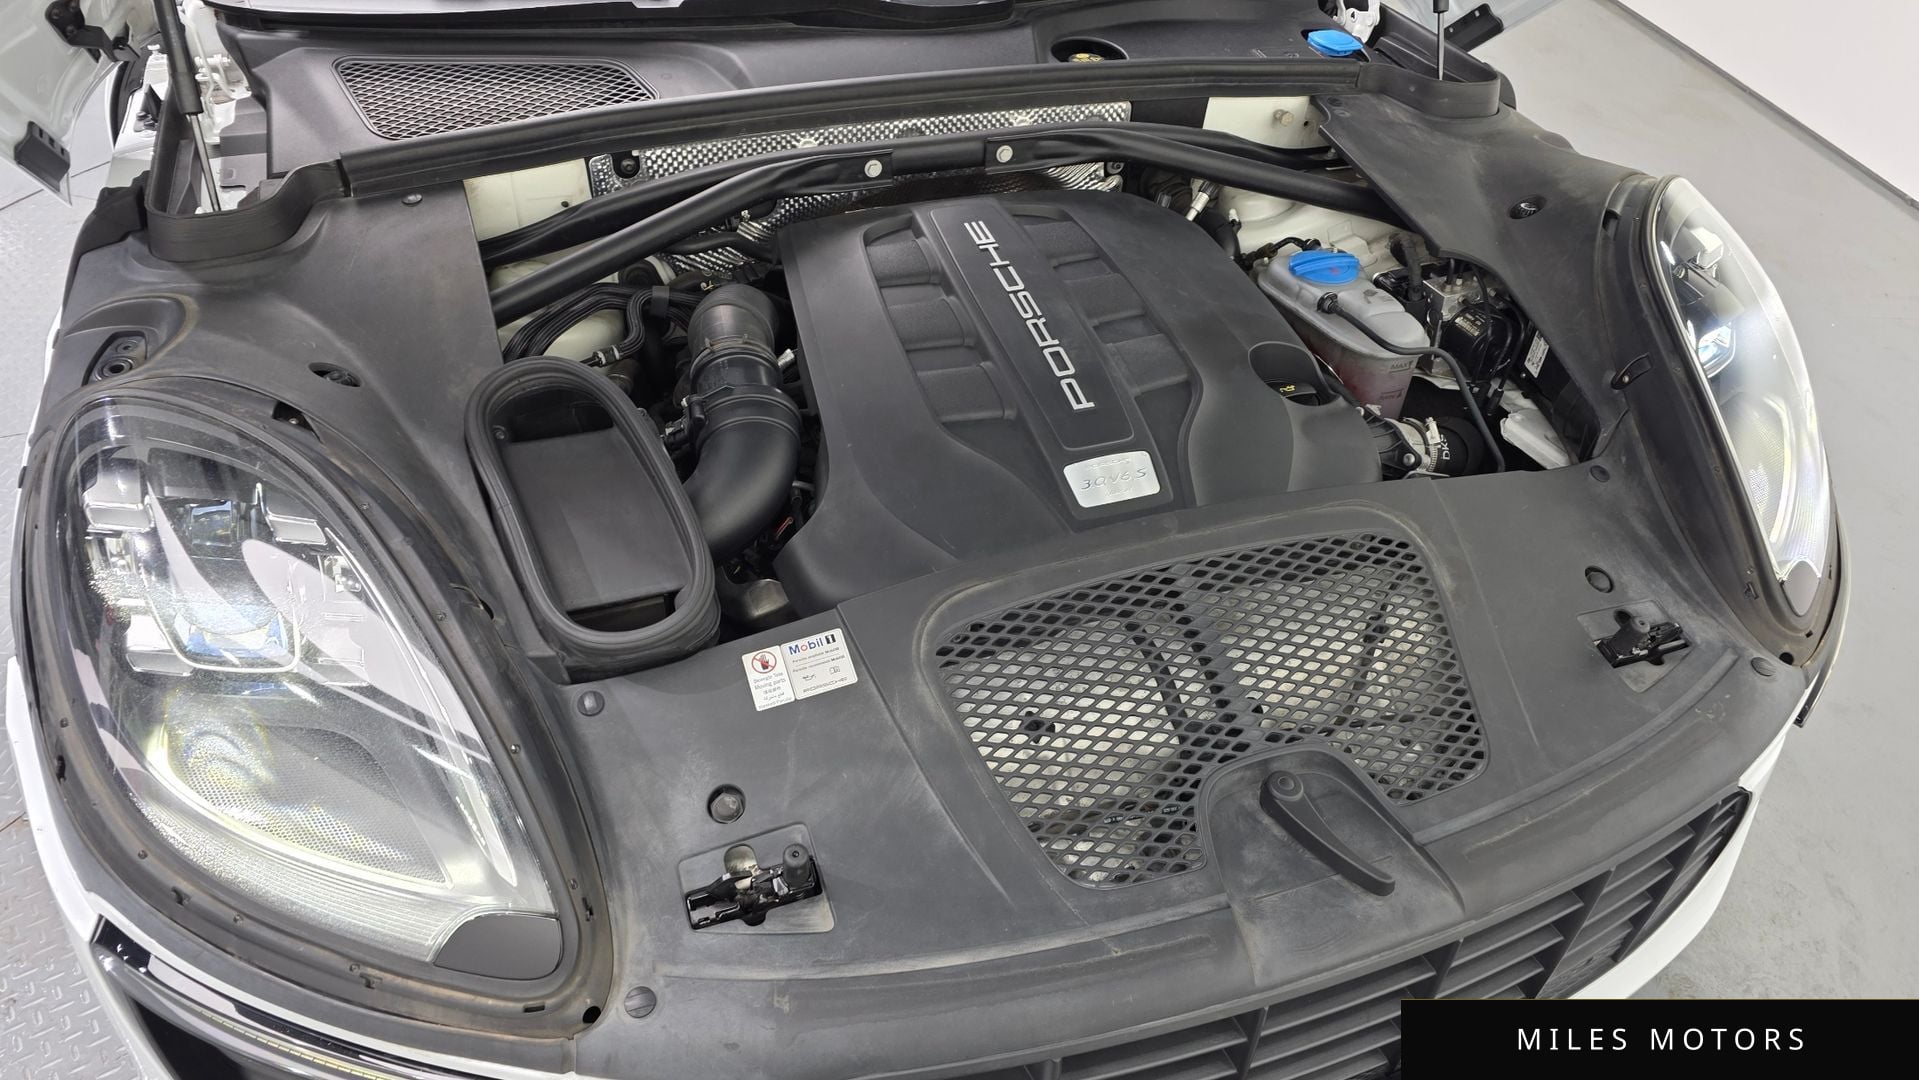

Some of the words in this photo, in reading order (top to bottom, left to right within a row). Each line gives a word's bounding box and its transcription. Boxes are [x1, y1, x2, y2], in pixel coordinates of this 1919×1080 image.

[964, 220, 1095, 411] PORSCHE
[1136, 467, 1147, 479] S
[788, 637, 824, 655] Mobil
[825, 634, 836, 644] 1
